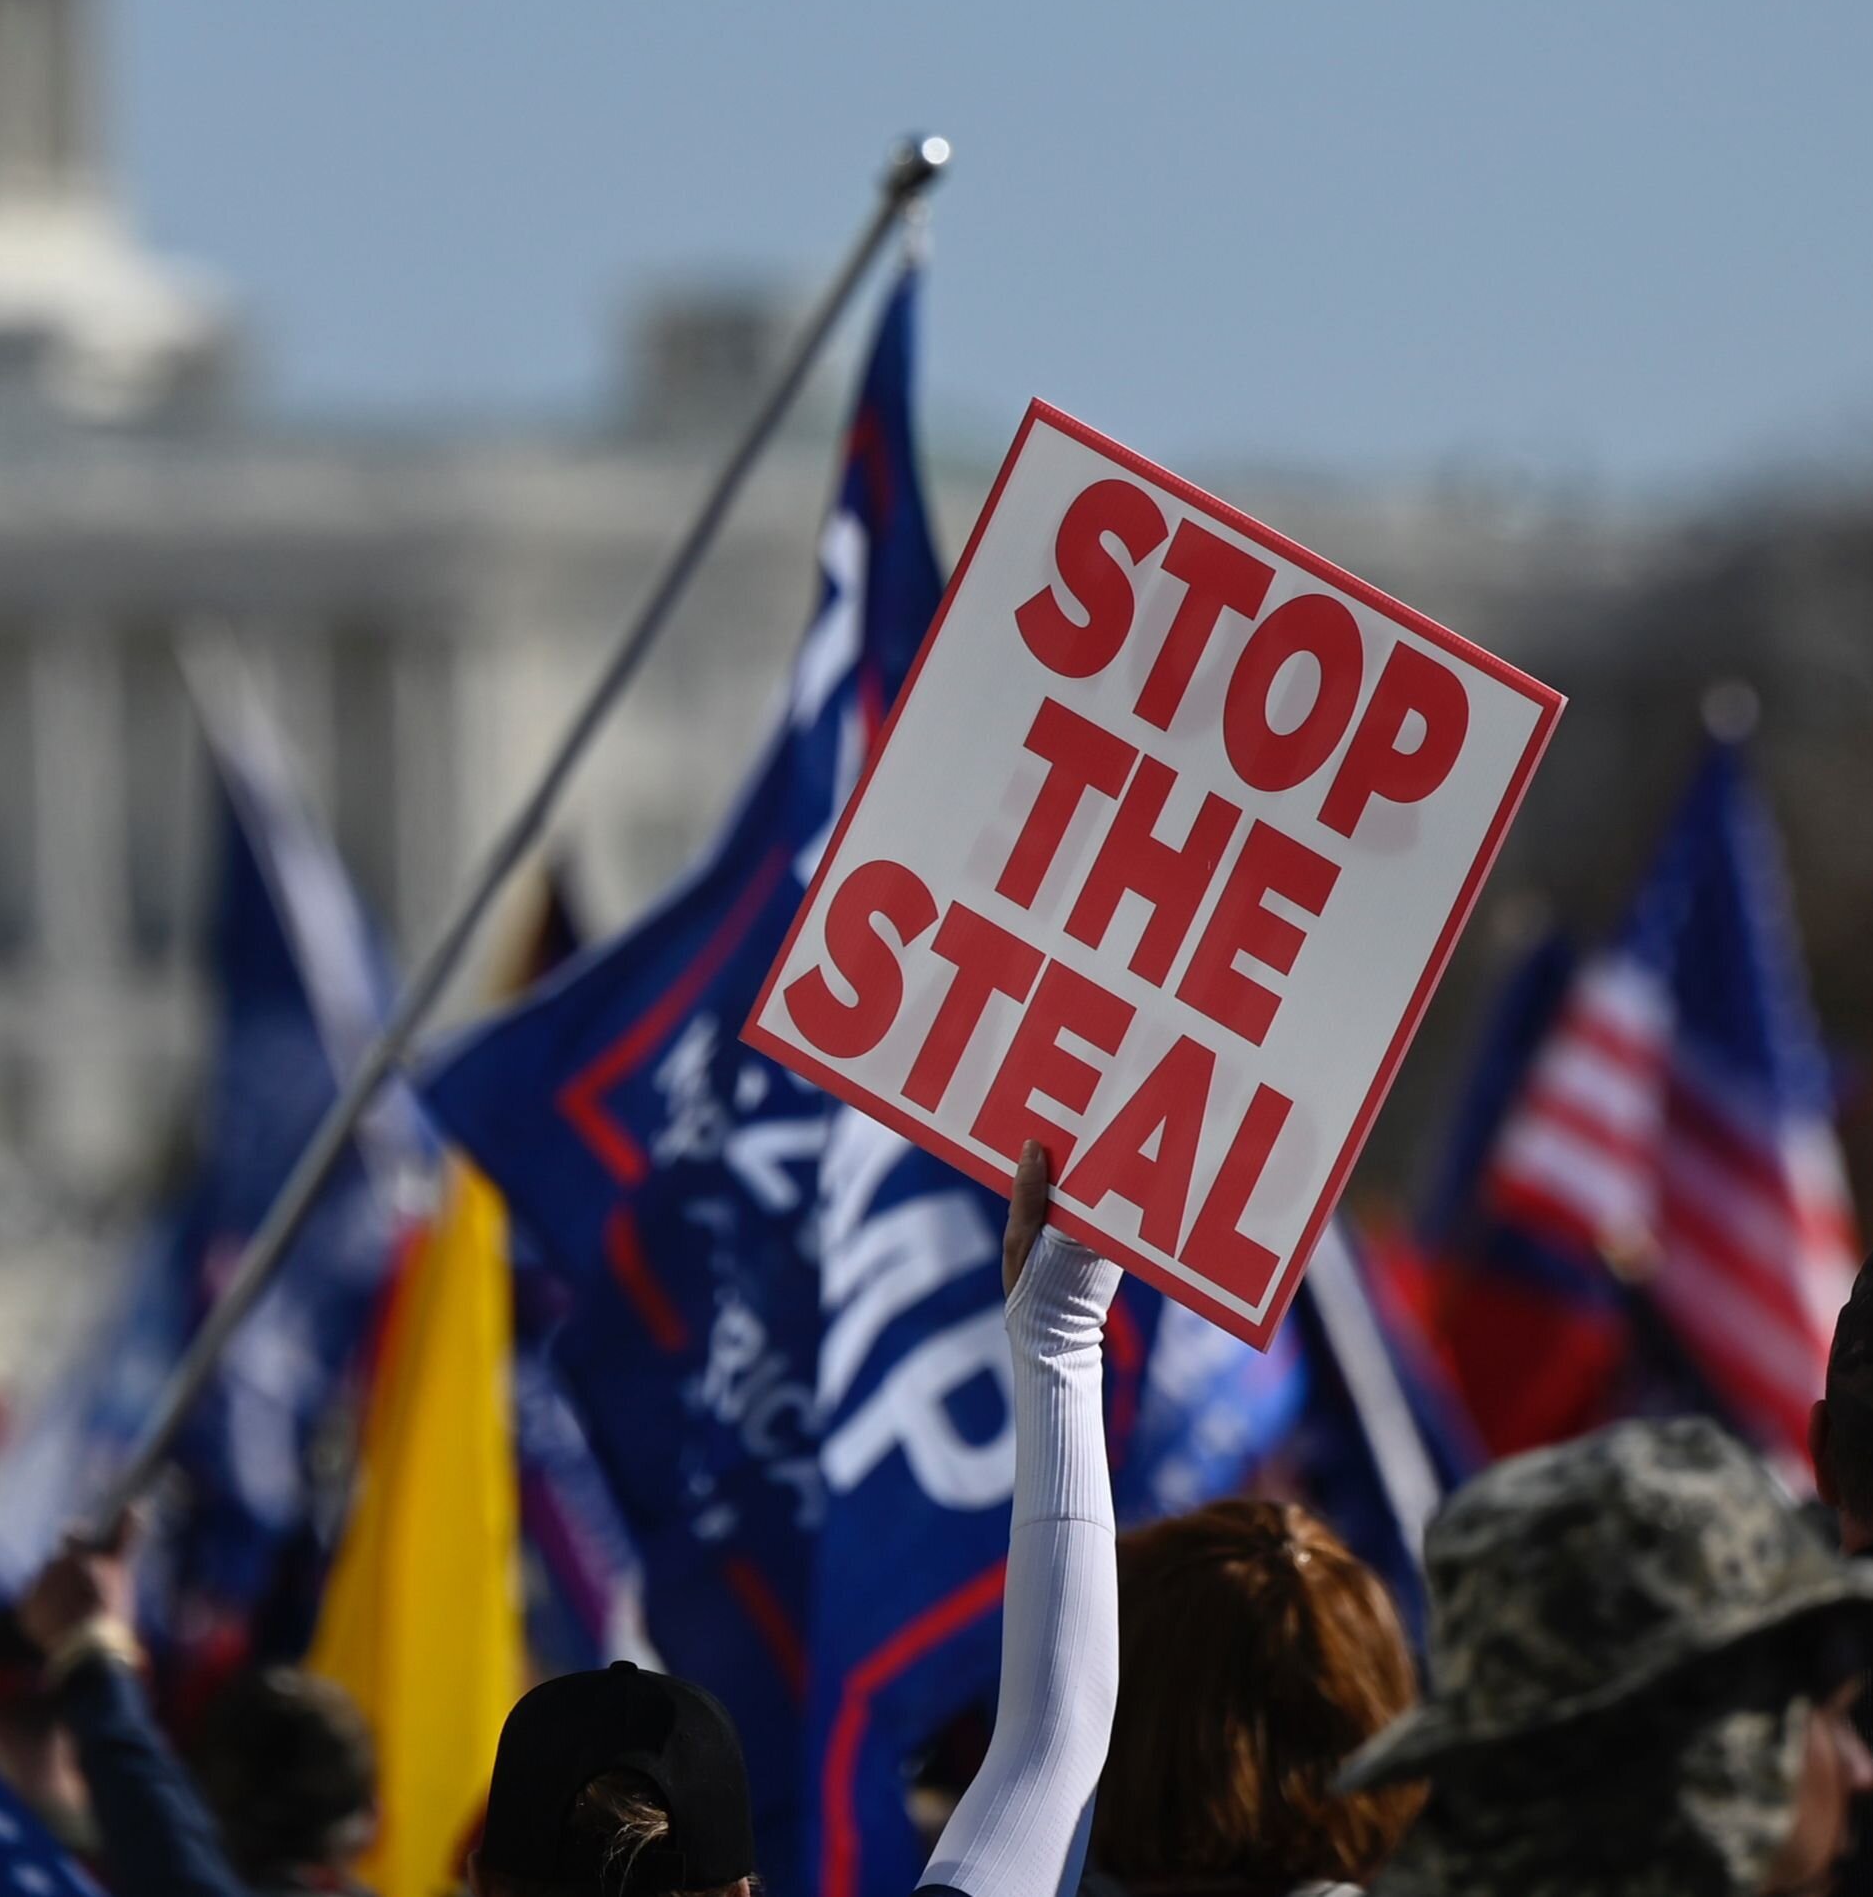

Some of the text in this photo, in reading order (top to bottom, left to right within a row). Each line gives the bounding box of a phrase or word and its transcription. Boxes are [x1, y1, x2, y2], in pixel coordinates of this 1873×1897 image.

[1015, 478, 1470, 837] STOP
[994, 697, 1342, 1045] THE
[784, 859, 1293, 1308] STEAL
